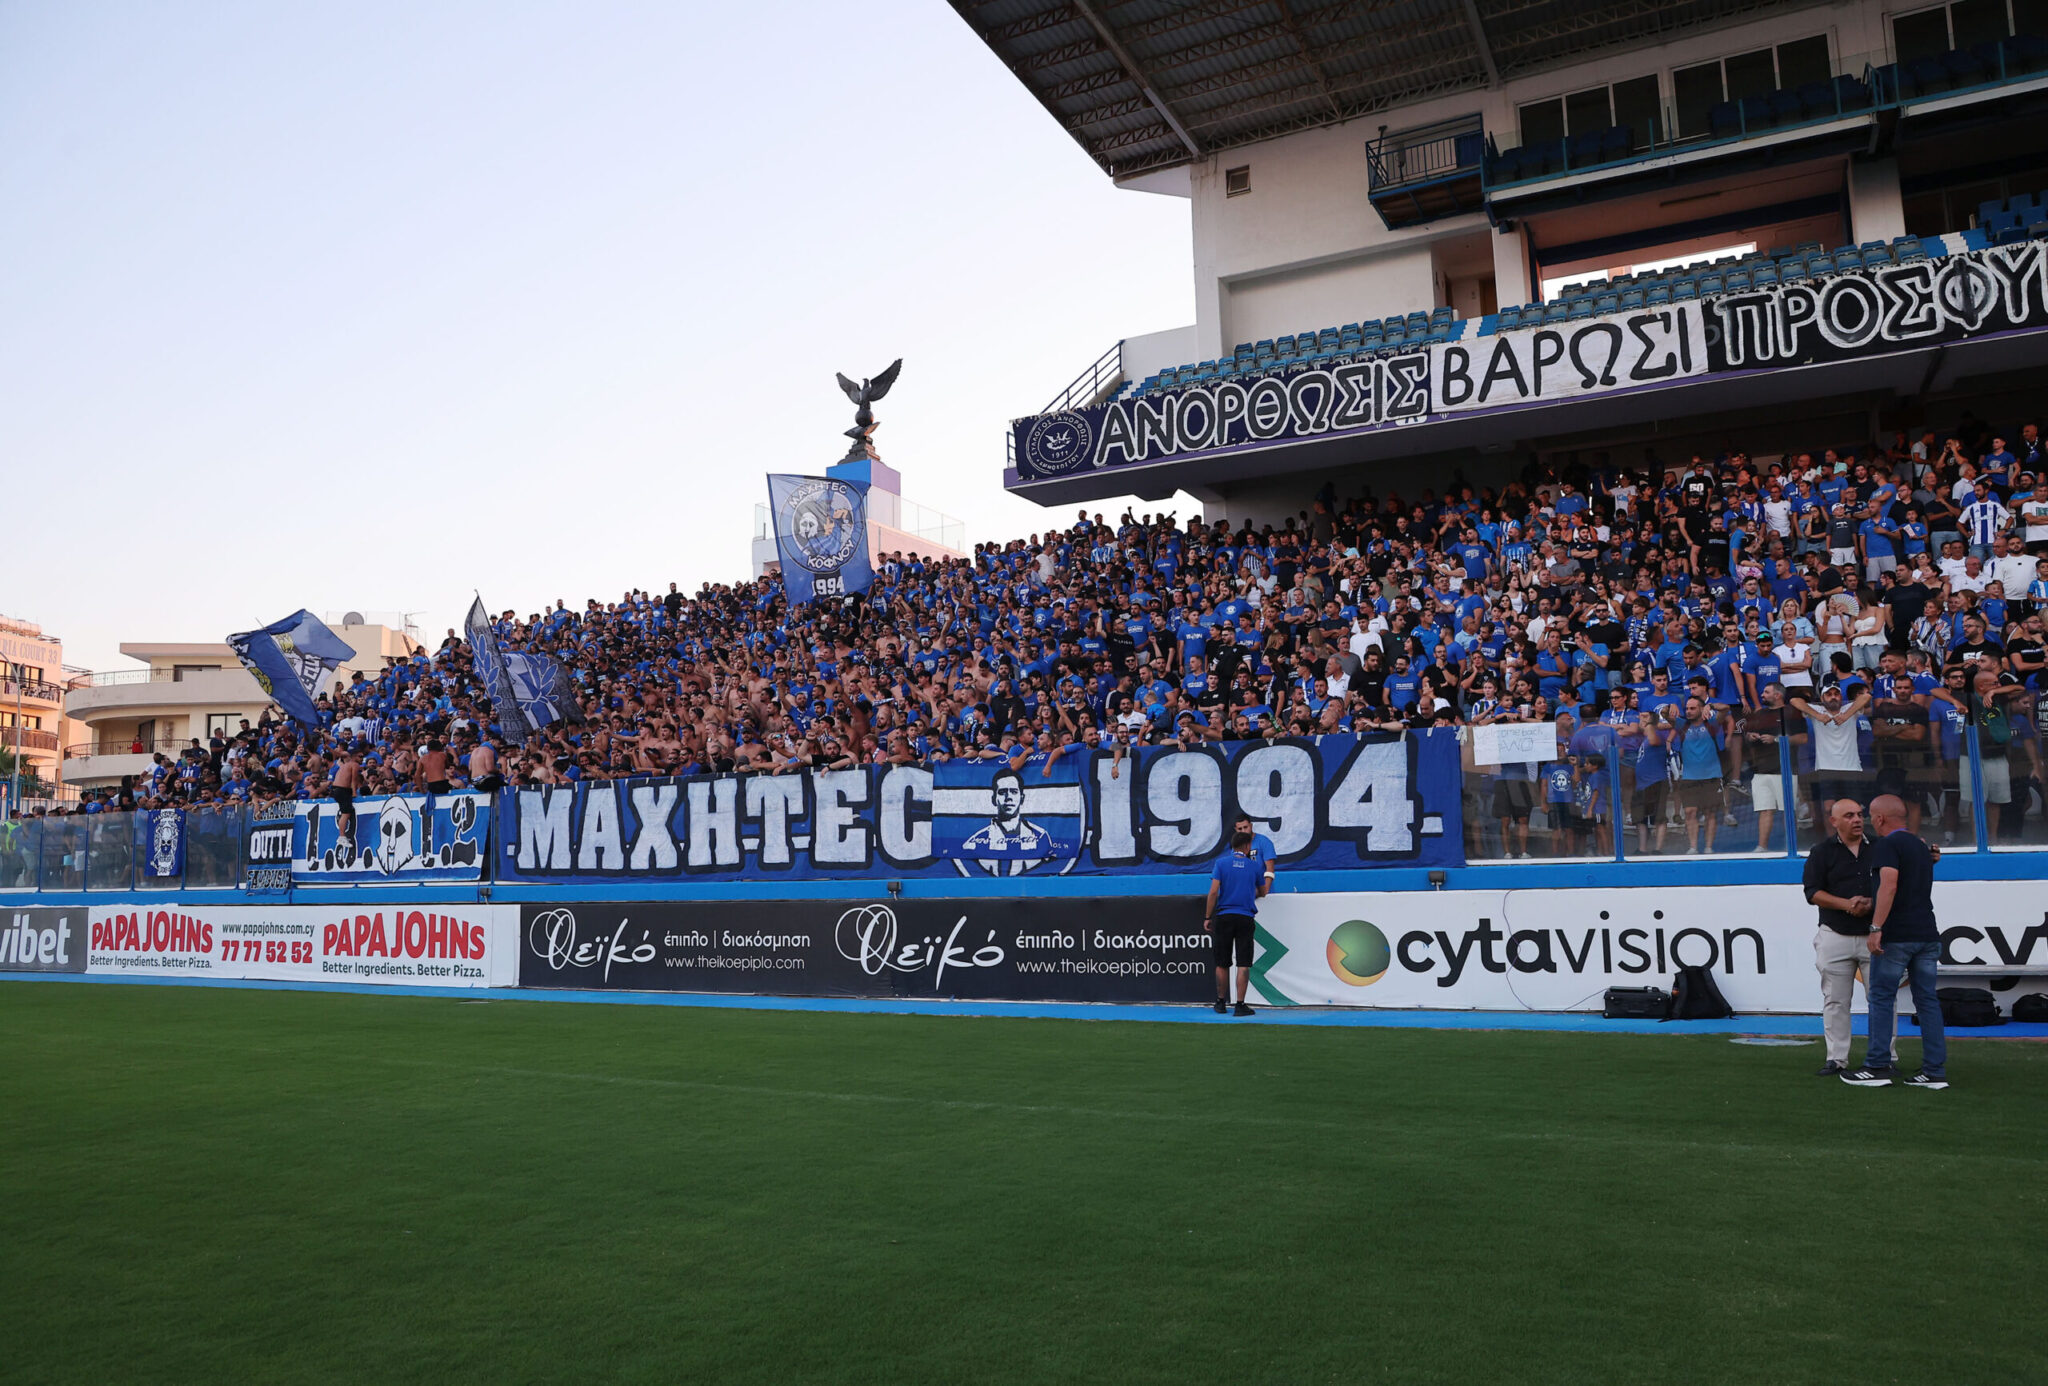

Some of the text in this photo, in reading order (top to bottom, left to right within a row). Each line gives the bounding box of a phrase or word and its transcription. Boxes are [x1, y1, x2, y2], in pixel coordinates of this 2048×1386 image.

[1094, 239, 2048, 467] ΑΝΟΡΘΩΣΙΣ ΒΑΡΩΣΙ ΠΡΟΣΦΥ
[1051, 450, 1069, 458] 1911
[811, 575, 846, 597] 1994
[20, 643, 46, 662] COURT
[48, 648, 58, 665] 33
[249, 829, 294, 860] OUTTA
[92, 911, 213, 953] PAPA JOHNS
[222, 922, 315, 937] www.papajohns.com.cy
[323, 911, 485, 960] PAPA JOHNS
[664, 930, 811, 951] έπιπλο διακόσμηση
[221, 940, 312, 964] 77 77 52 52
[1015, 929, 1213, 954] έπιπλο διακόσμηση
[1397, 910, 1766, 988] cytavision
[1939, 911, 2048, 991] cy
[90, 955, 213, 970] Better Ingredients. Better Pizza.
[322, 961, 485, 978] Better Ingredients. Better Pizza.
[664, 955, 805, 971] www.theikoepiplo.com
[1016, 958, 1206, 978] www.theikoepiplo.com
